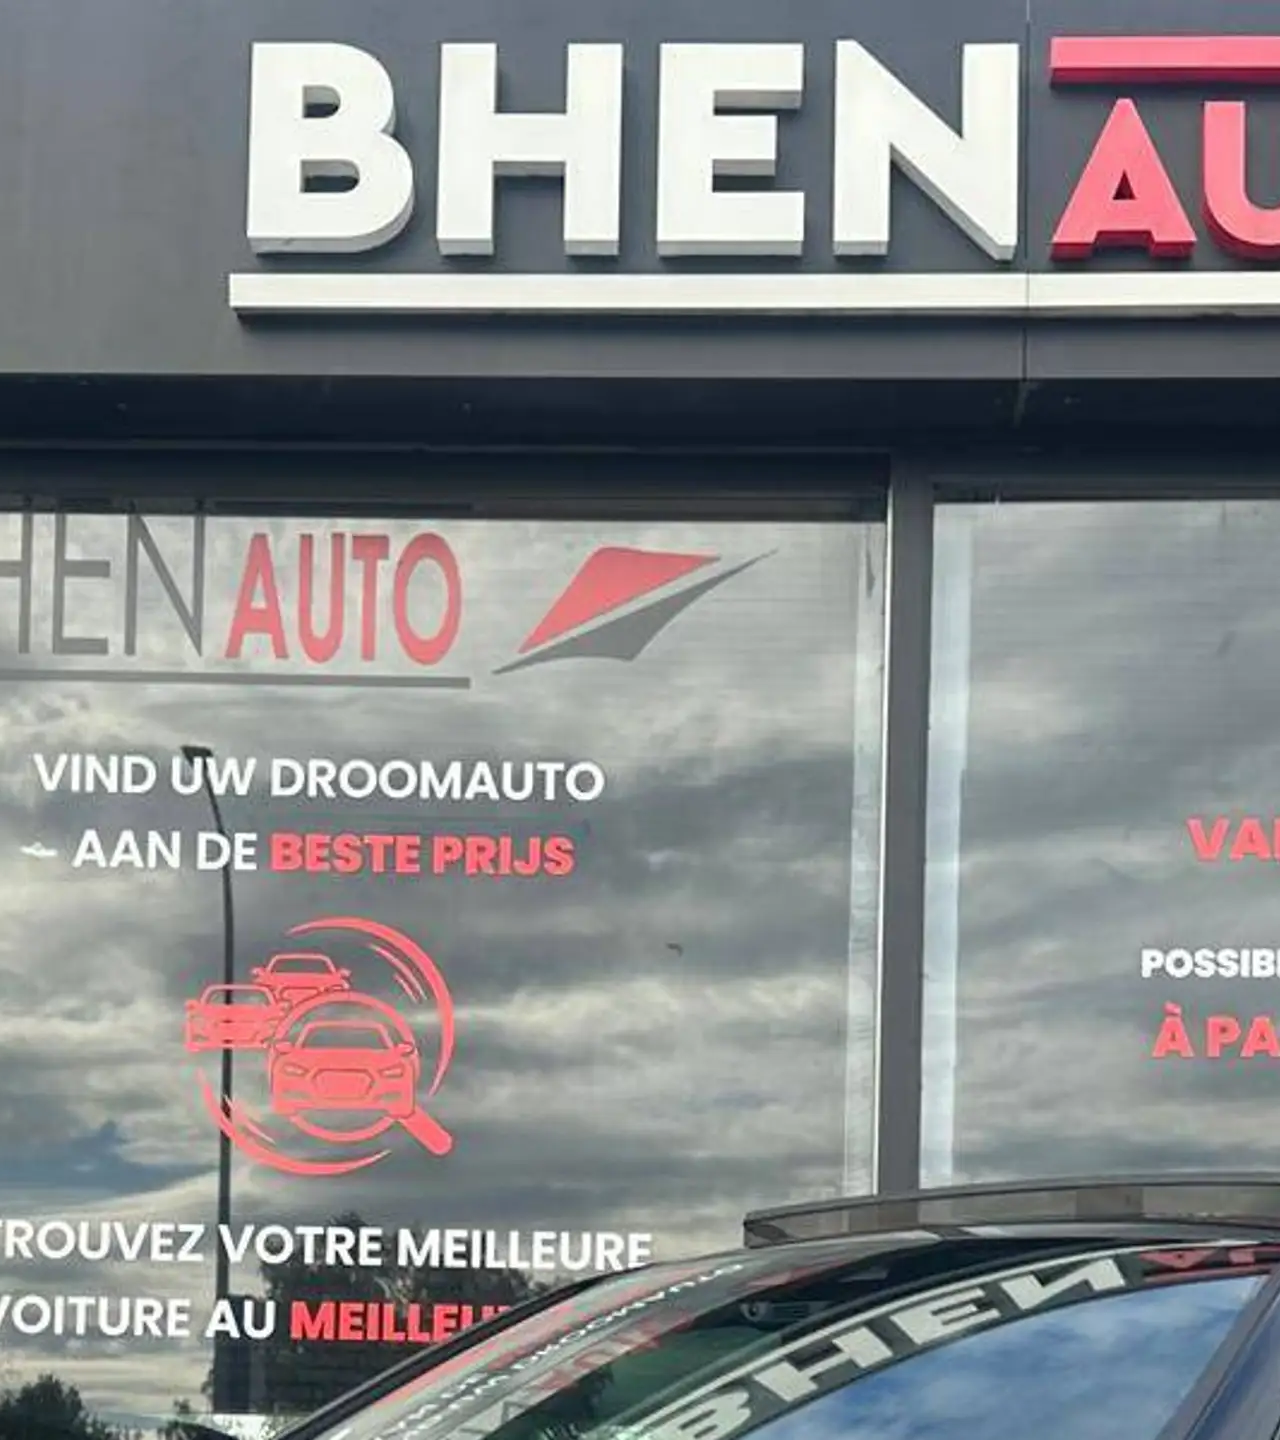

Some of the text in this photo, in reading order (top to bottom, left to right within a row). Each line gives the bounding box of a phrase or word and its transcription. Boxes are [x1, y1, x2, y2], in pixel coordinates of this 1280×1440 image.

[32, 752, 606, 802] VIND UW DROOMAUTO
[71, 829, 575, 880] AAN DE BESTE PRIJS
[1152, 1002, 1193, 1058] À
[218, 1223, 383, 1267] VOTRE
[397, 1228, 654, 1272] MEILLEURE
[205, 1299, 276, 1339] AU
